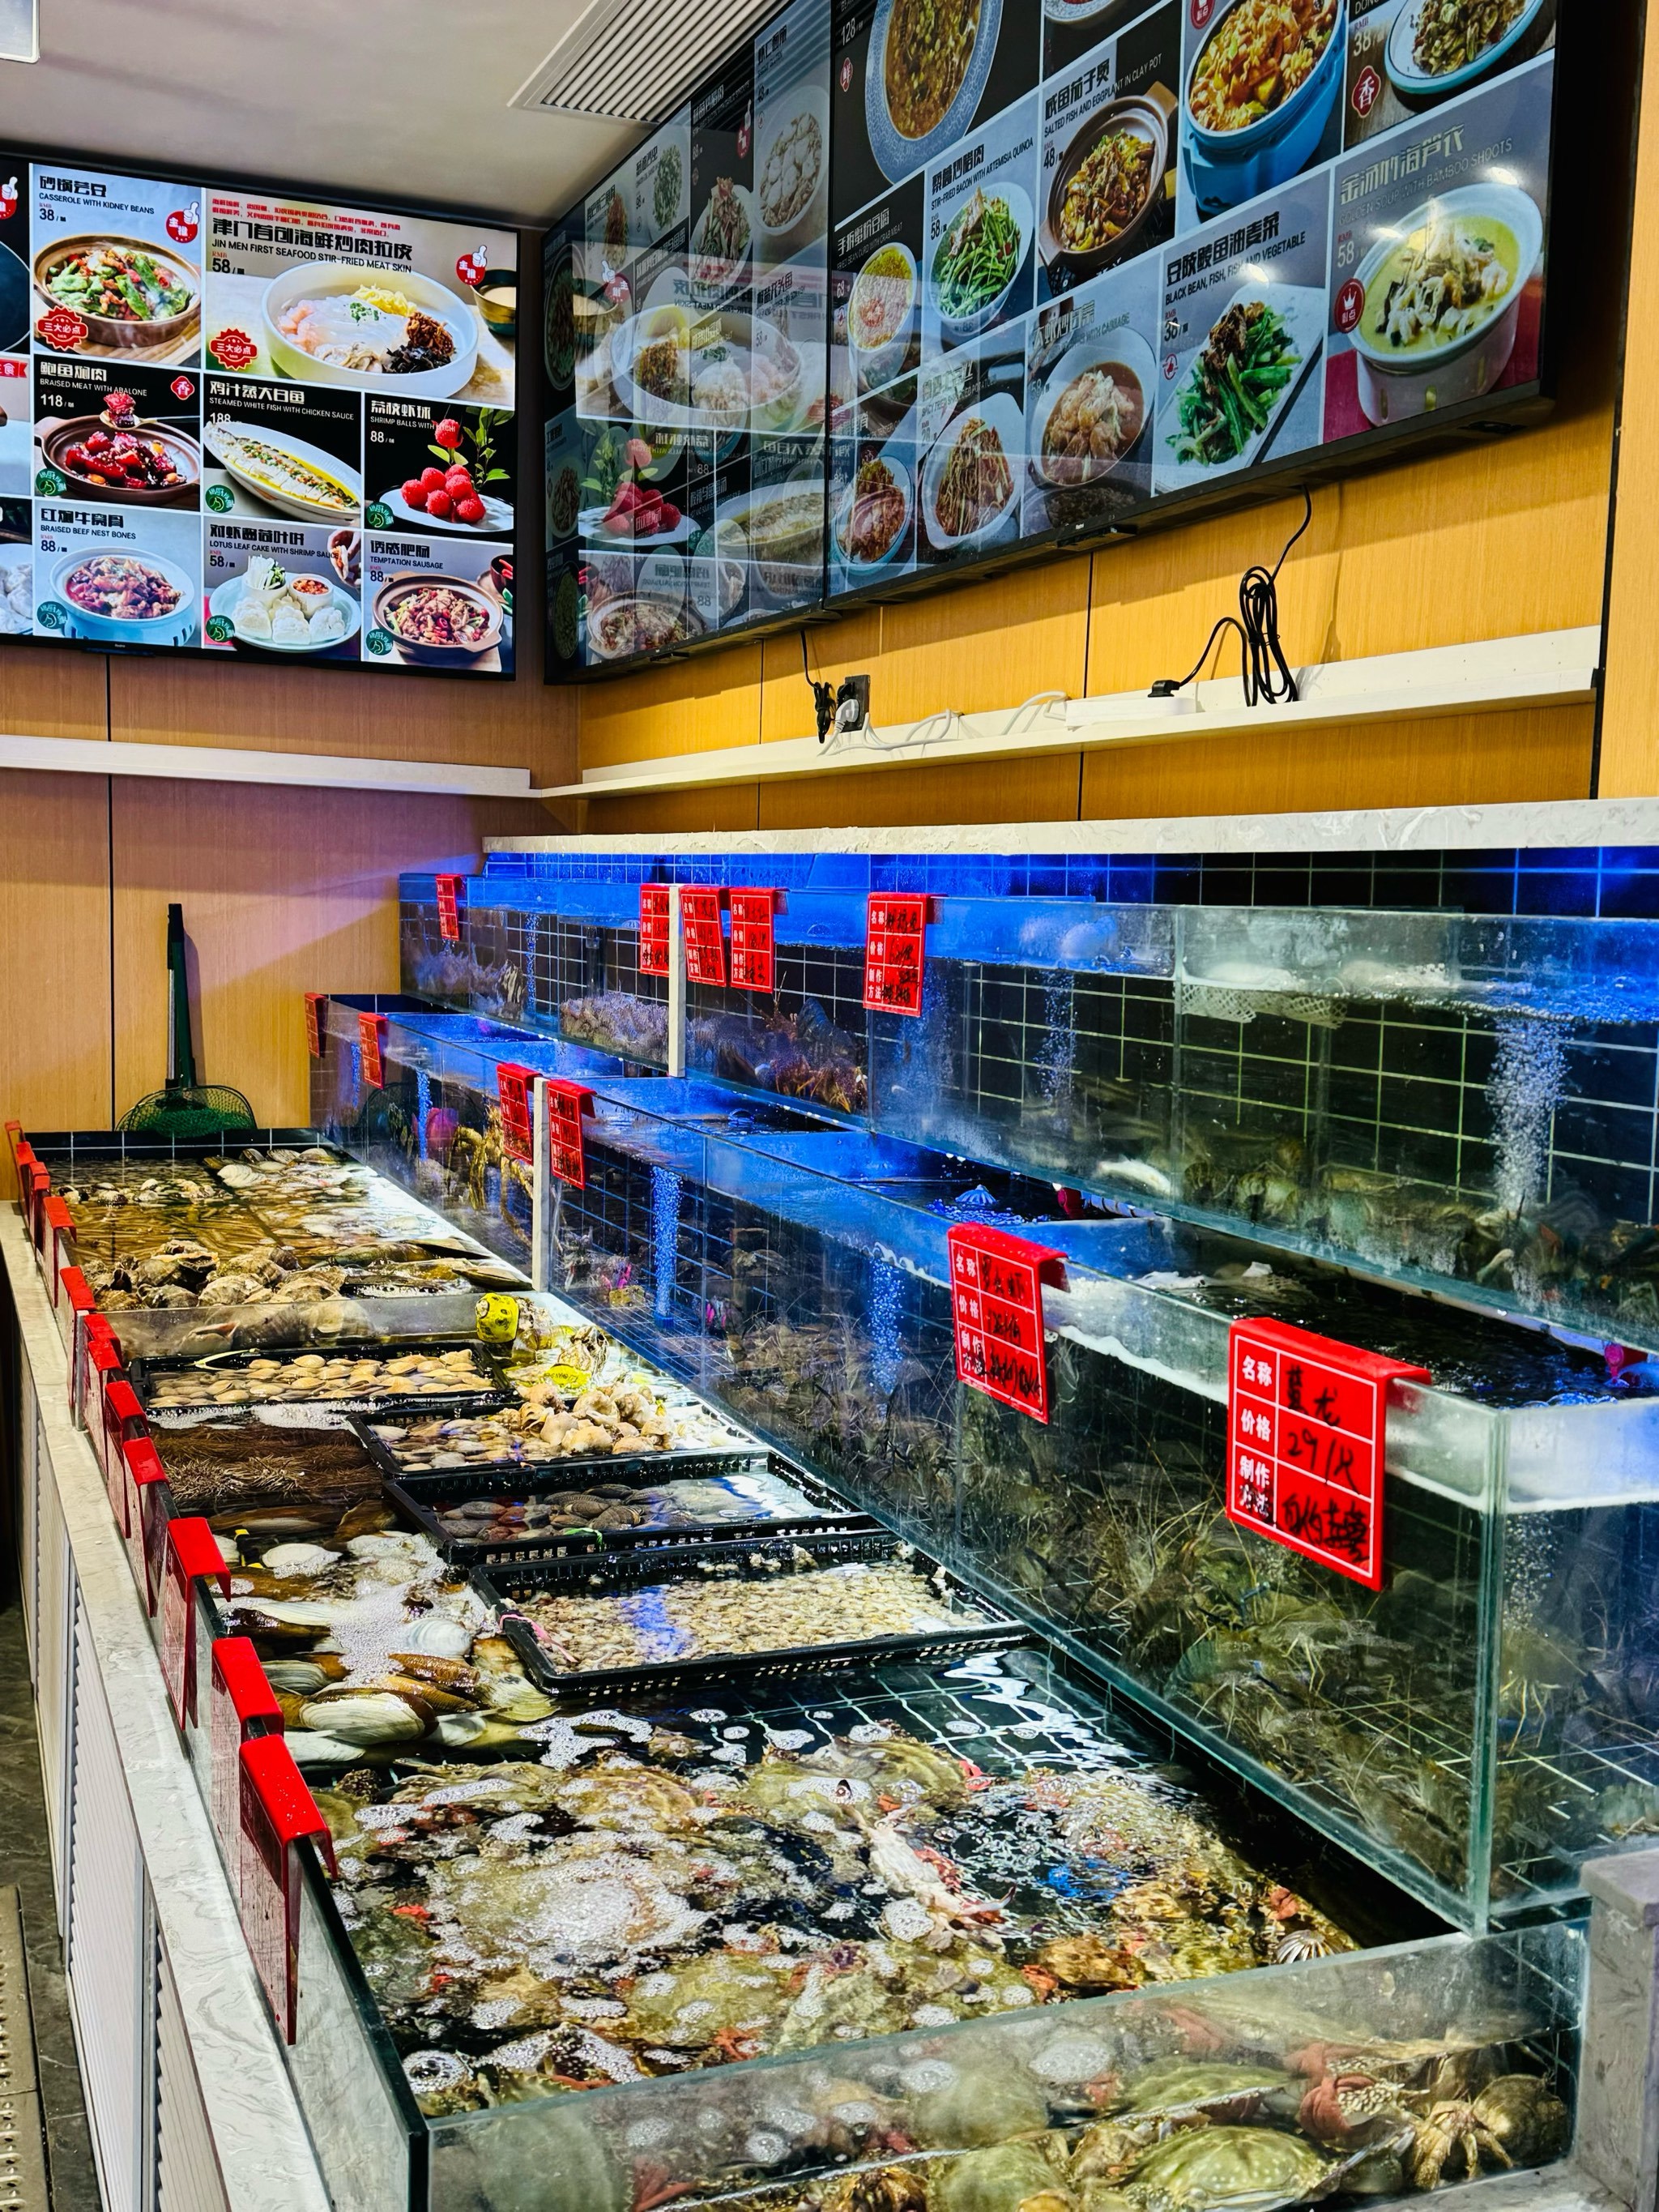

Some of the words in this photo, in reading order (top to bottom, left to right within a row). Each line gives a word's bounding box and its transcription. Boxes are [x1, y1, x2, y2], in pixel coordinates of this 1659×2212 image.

[842, 17, 856, 45] 128
[1354, 30, 1371, 57] 38
[1044, 118, 1065, 138] SALTED
[1065, 108, 1078, 125] FISH
[1079, 99, 1092, 116] AND
[1093, 79, 1124, 108] EGGPLANT
[1124, 75, 1132, 87] IN
[1132, 64, 1148, 82] CLAY
[1149, 53, 1162, 70] POT
[1358, 75, 1375, 109] 香
[1043, 147, 1056, 169] 48
[932, 187, 956, 210] STIR-FRIED
[956, 179, 972, 195] BACON
[973, 168, 986, 183] WITH
[986, 153, 1012, 175] ARTEMISIA
[1013, 137, 1034, 158] QUINOA
[1376, 190, 1400, 211] SOUP
[1427, 159, 1469, 187] BAMBOO
[1471, 138, 1512, 166] SHOOTS
[40, 176, 106, 197] 砂锅芸豆
[39, 193, 81, 204] CASSEROLE
[83, 199, 101, 207] WITH
[103, 202, 129, 211] KIDNEY
[130, 205, 155, 214] BEANS
[39, 208, 54, 221] 38
[213, 217, 412, 260] 津门首创海鲜炒肉拉皮
[931, 219, 940, 241] 58
[212, 239, 226, 248] JIN
[228, 241, 248, 251] MEN
[250, 243, 274, 254] FIRST
[275, 247, 316, 260] SEAFOOD
[318, 253, 365, 267] STIR-FRIED
[367, 259, 390, 271] MEAT
[392, 263, 412, 273] SKIN
[1337, 241, 1354, 268] 58
[212, 258, 230, 274] 58
[1166, 287, 1187, 305] BLACK
[1188, 278, 1208, 295] BEAN,
[1209, 269, 1226, 286] FISH,
[1262, 231, 1306, 259] VEGETABLE
[45, 322, 80, 335] 三大必点
[216, 343, 251, 355] 三大必点
[41, 361, 107, 382] 鲍鱼焖肉
[40, 378, 70, 388] BRAISED
[72, 382, 92, 391] MEAT
[94, 384, 112, 392] WITH
[114, 386, 147, 396] ABALONE
[210, 381, 305, 404] 鸡汁蒸大白鱼
[41, 393, 63, 408] 118
[209, 397, 242, 407] STEAMED
[244, 401, 265, 410] WHITE
[267, 404, 282, 412] FISH
[284, 406, 301, 414] WITH
[301, 408, 331, 417] CHICKEN
[331, 412, 354, 421] SAUCE
[371, 400, 431, 420] 荔枝虾球
[210, 412, 231, 424] 188
[370, 416, 395, 425] SHRIMP
[397, 420, 417, 428] BALLS
[370, 430, 385, 443] 88
[41, 525, 71, 534] BRAISED
[112, 532, 136, 540] BONES
[41, 540, 56, 552] 88
[210, 540, 232, 549] LOTUS
[271, 546, 288, 554] WITH
[289, 548, 315, 557] SHRIMP
[317, 550, 339, 559] SAUCE
[370, 540, 429, 558] 诱惑肥肠
[210, 555, 224, 567] 58
[370, 556, 411, 566] TEMPTATION
[412, 560, 443, 569] SAUSAGE
[370, 570, 383, 582] 88
[871, 910, 885, 925] 名称
[870, 941, 883, 956] 价格
[868, 969, 882, 983] 制作
[868, 985, 881, 1000] 方法
[956, 1253, 976, 1278] 名称
[958, 1294, 979, 1320] 价格
[961, 1330, 983, 1354] 制作
[1242, 1356, 1273, 1387] 名称
[1240, 1408, 1271, 1442] 价格
[1239, 1454, 1270, 1489] 制作
